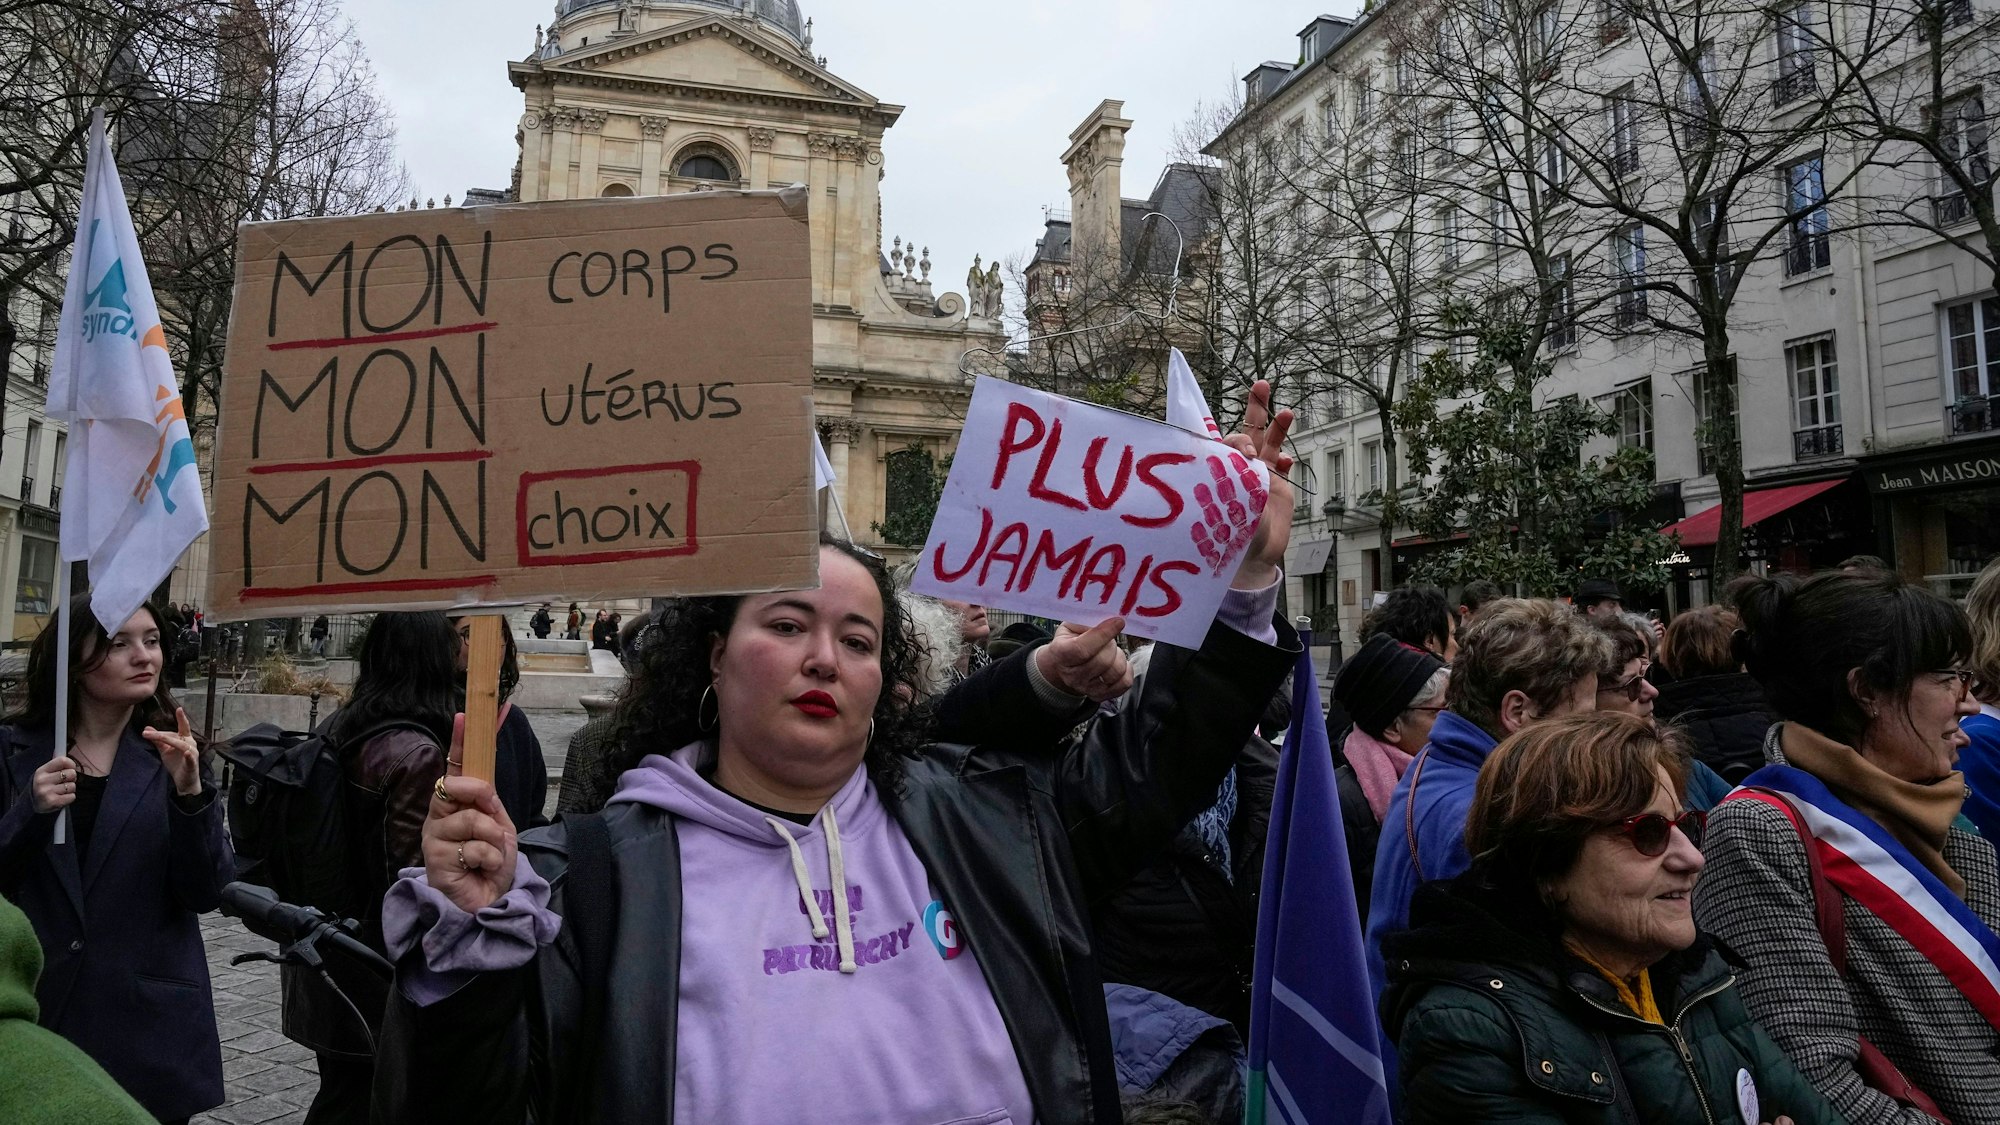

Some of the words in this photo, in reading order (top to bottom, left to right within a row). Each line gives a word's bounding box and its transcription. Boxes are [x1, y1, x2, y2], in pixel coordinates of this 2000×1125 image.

[267, 230, 492, 339] MON
[252, 332, 486, 459] MON
[990, 401, 1196, 528] PLUS
[1880, 473, 1912, 490] Jean
[243, 460, 486, 588] MON
[527, 488, 674, 551] choix
[933, 507, 1200, 617] JAMAIS
